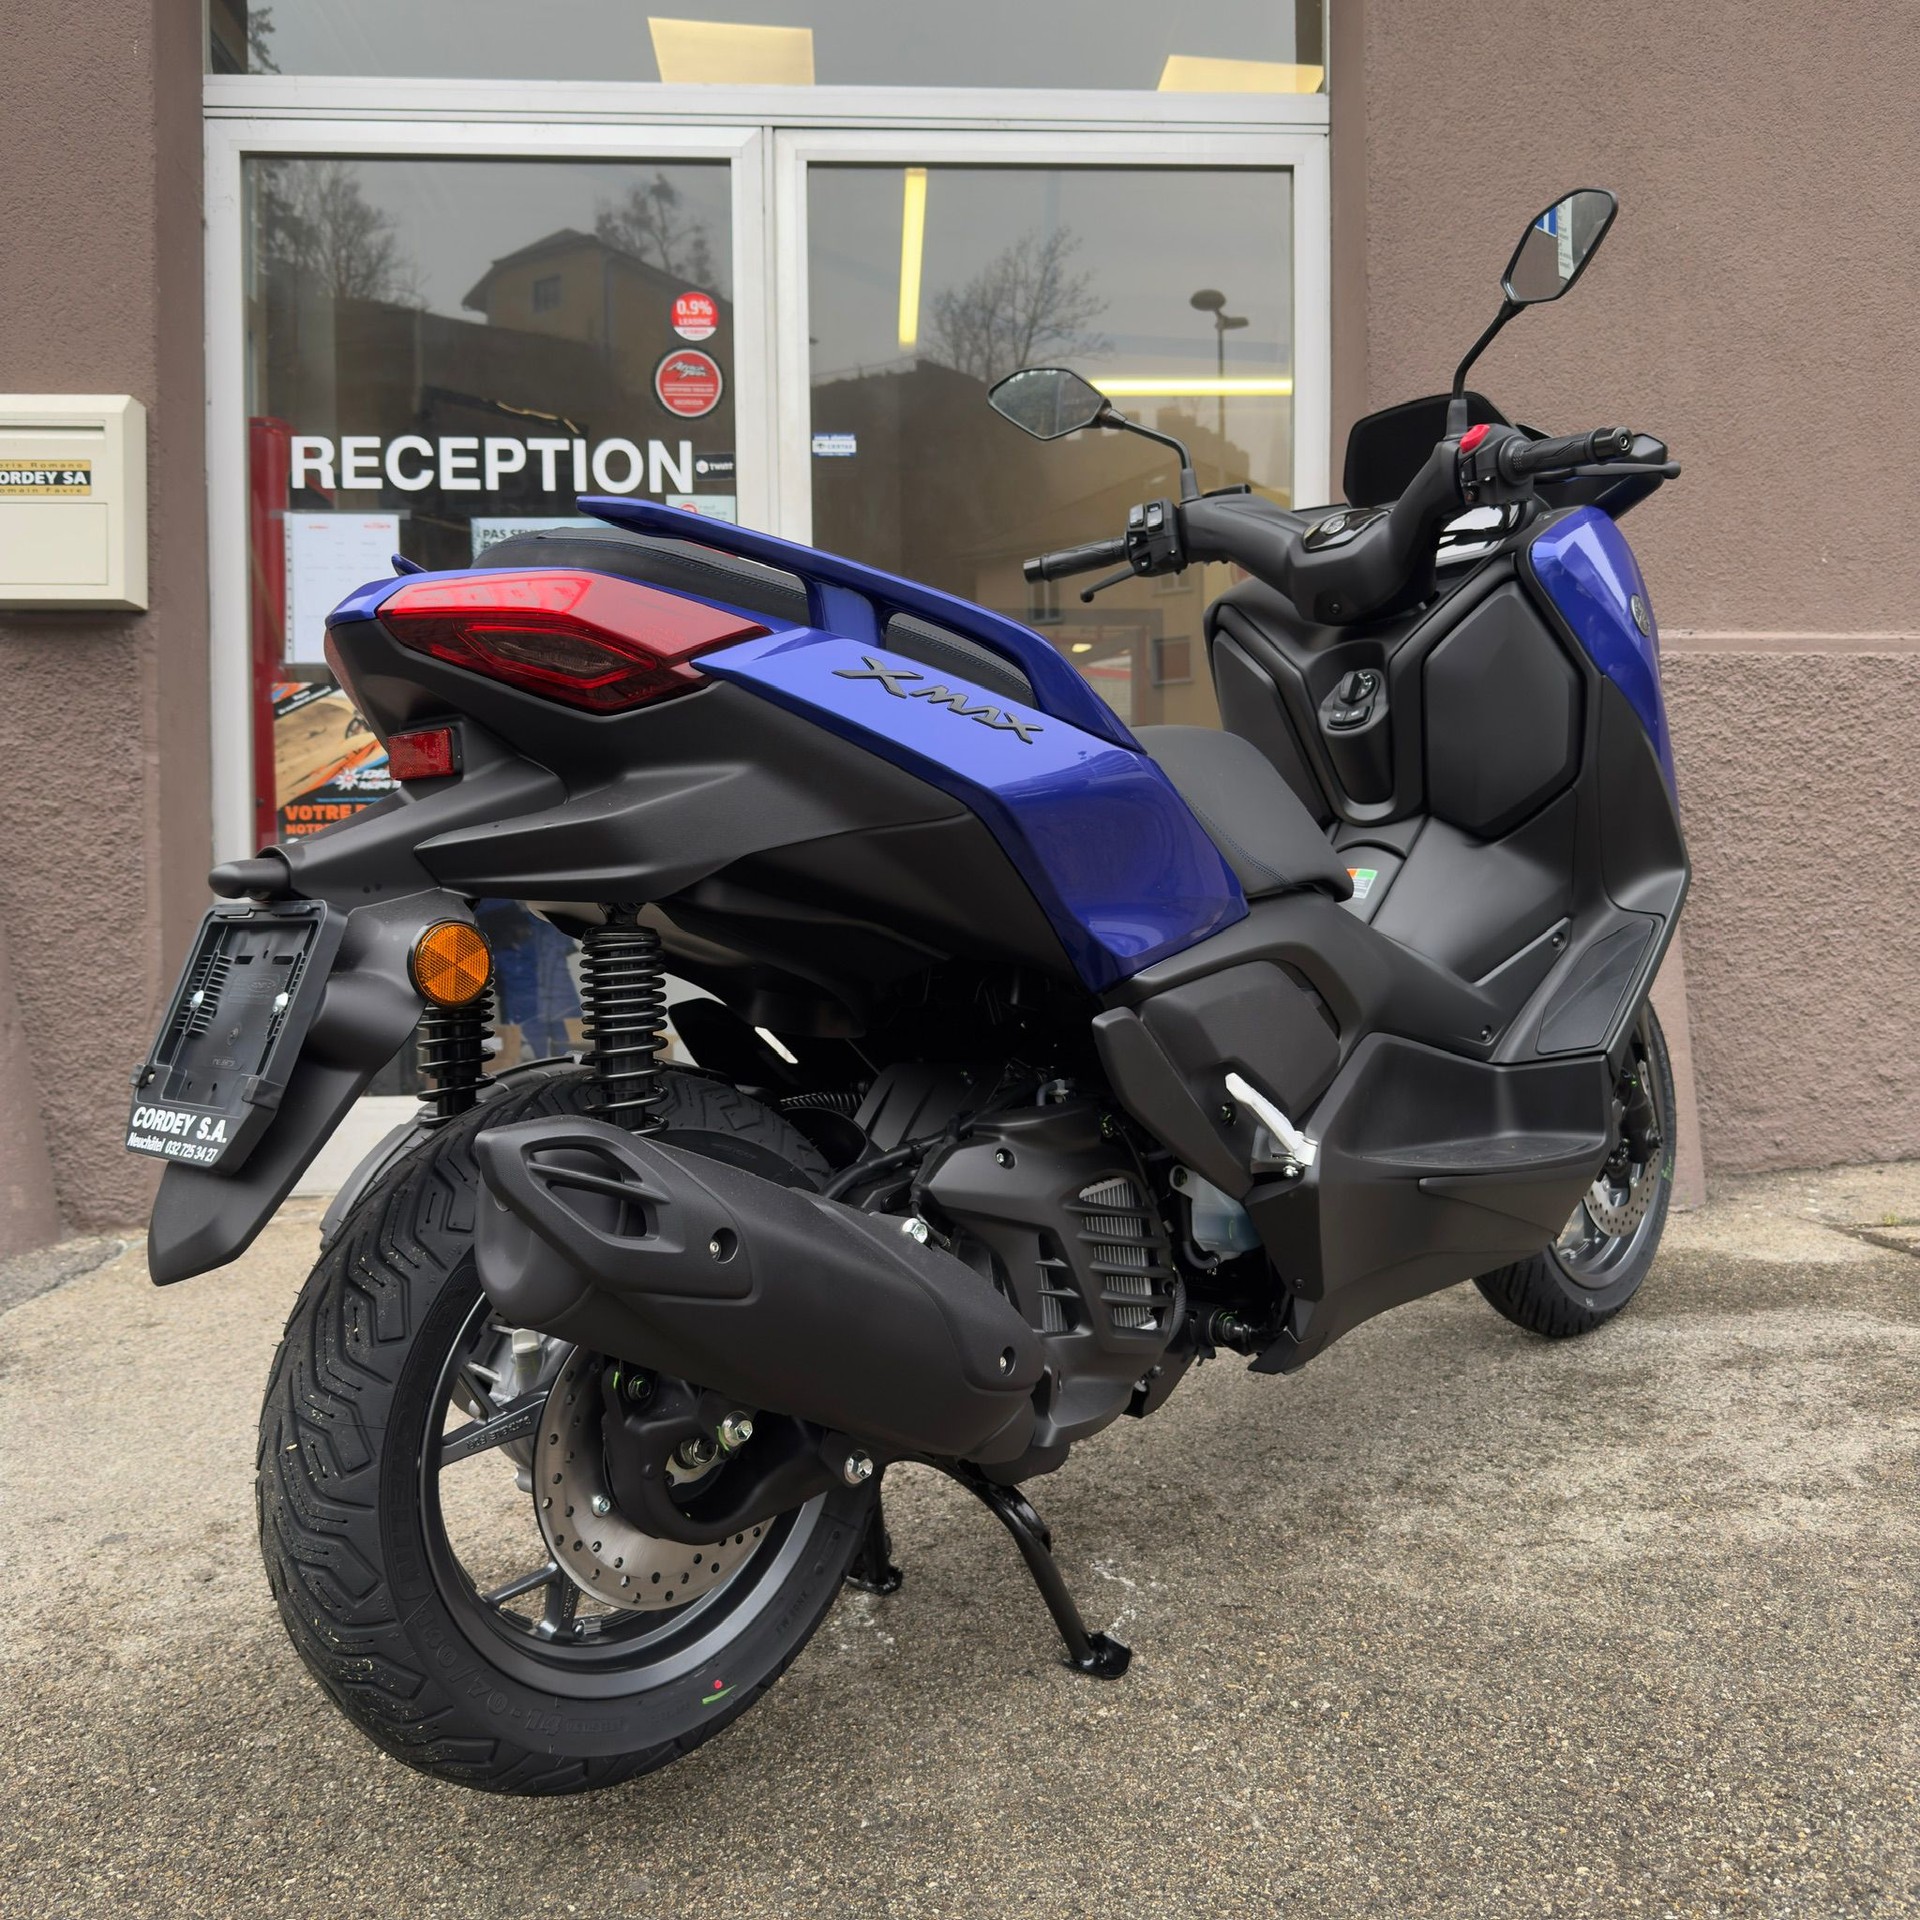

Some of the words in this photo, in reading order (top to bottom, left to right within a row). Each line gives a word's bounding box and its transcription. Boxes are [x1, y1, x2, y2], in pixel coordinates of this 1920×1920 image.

[676, 299, 712, 315] 0.9%
[291, 434, 694, 494] RECEPTION
[62, 471, 87, 485] SA
[483, 529, 506, 540] PAS
[285, 805, 351, 820] VOTRE
[132, 1107, 197, 1136] CORDEY
[196, 1117, 227, 1143] S.A.
[127, 1132, 165, 1152] Neuchâtel
[164, 1140, 182, 1156] 032
[179, 1143, 196, 1158] 725
[194, 1146, 208, 1160] 34
[205, 1148, 218, 1162] 27
